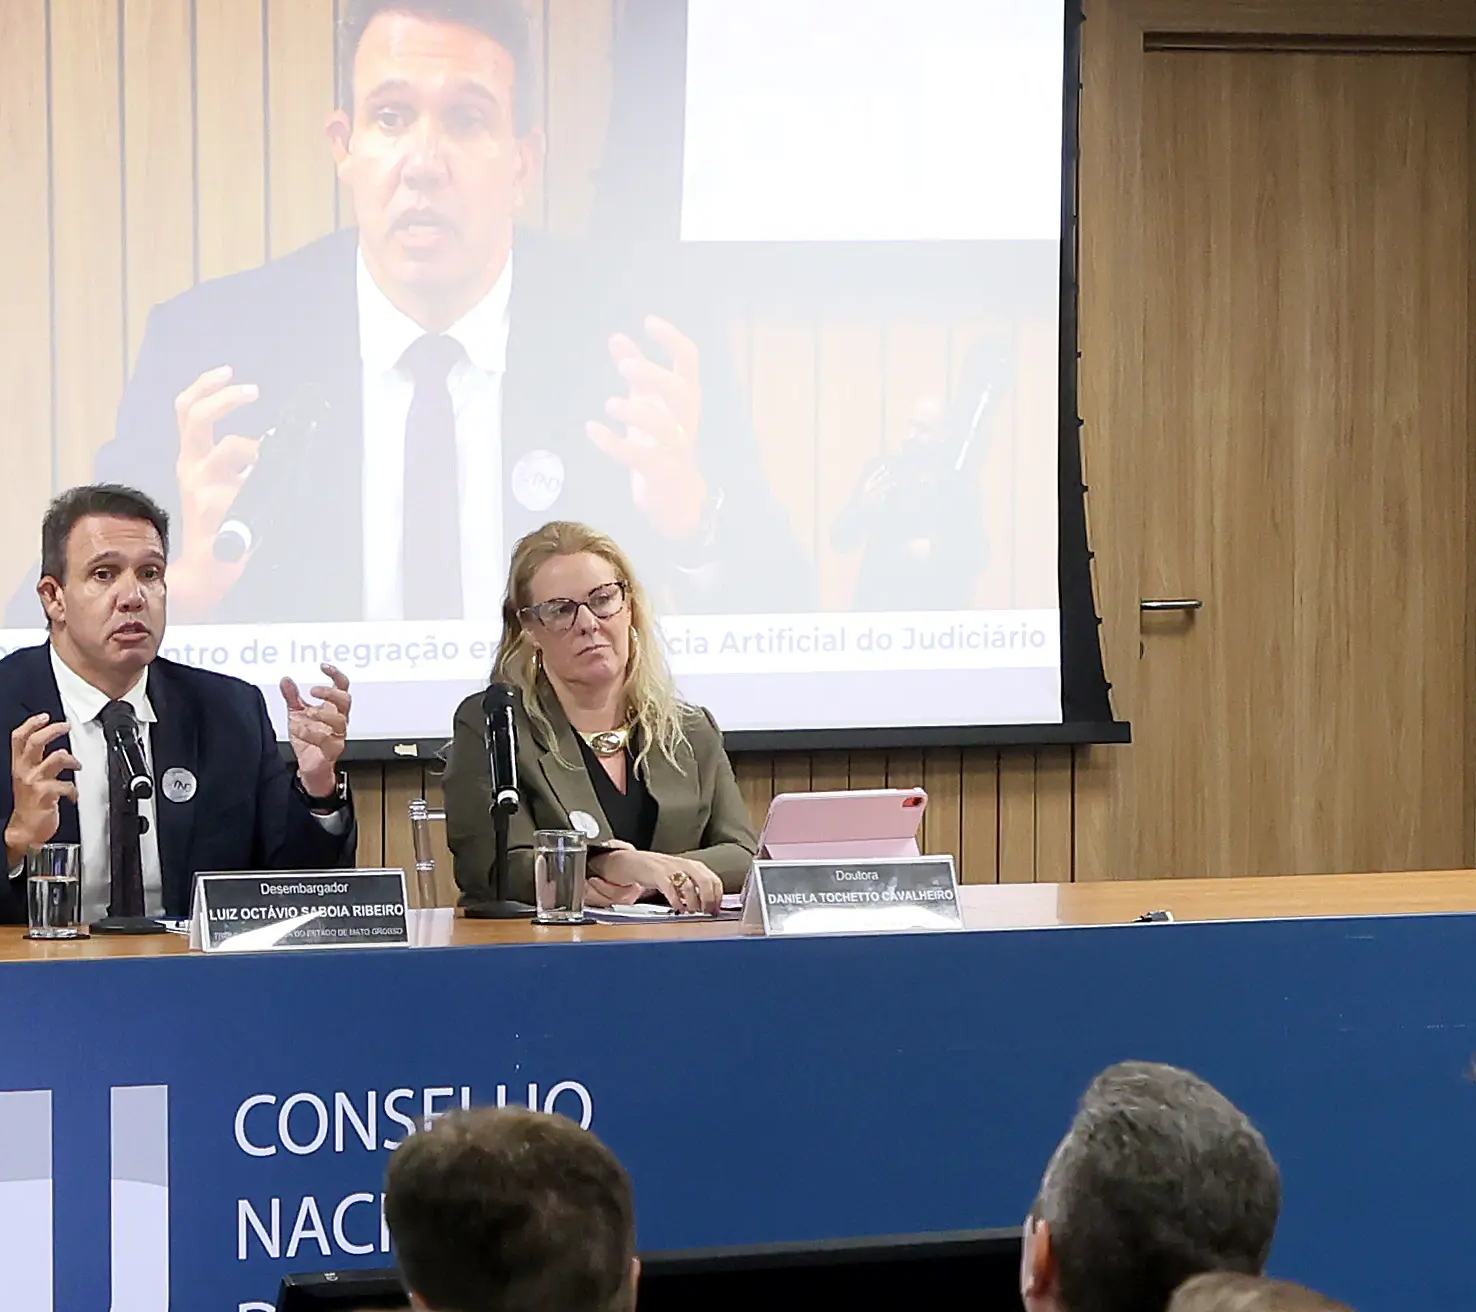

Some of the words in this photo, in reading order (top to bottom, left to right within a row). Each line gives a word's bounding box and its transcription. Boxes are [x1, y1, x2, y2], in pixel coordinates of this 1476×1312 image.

[719, 627, 846, 655] Artificial
[856, 627, 893, 652] do
[904, 622, 1047, 651] Judiciário
[163, 643, 230, 665] ntro
[240, 639, 278, 665] de
[291, 635, 467, 670] Integração
[835, 869, 879, 881] Doutora
[260, 882, 349, 897] Desembargador
[767, 892, 818, 905] DANIELA
[818, 891, 880, 903] TOCHETTO
[881, 889, 954, 902] CAVALHEIRO
[208, 908, 239, 922] LUIZ
[240, 904, 299, 921] OCTÁVIO
[352, 903, 404, 918] RIBEIRO
